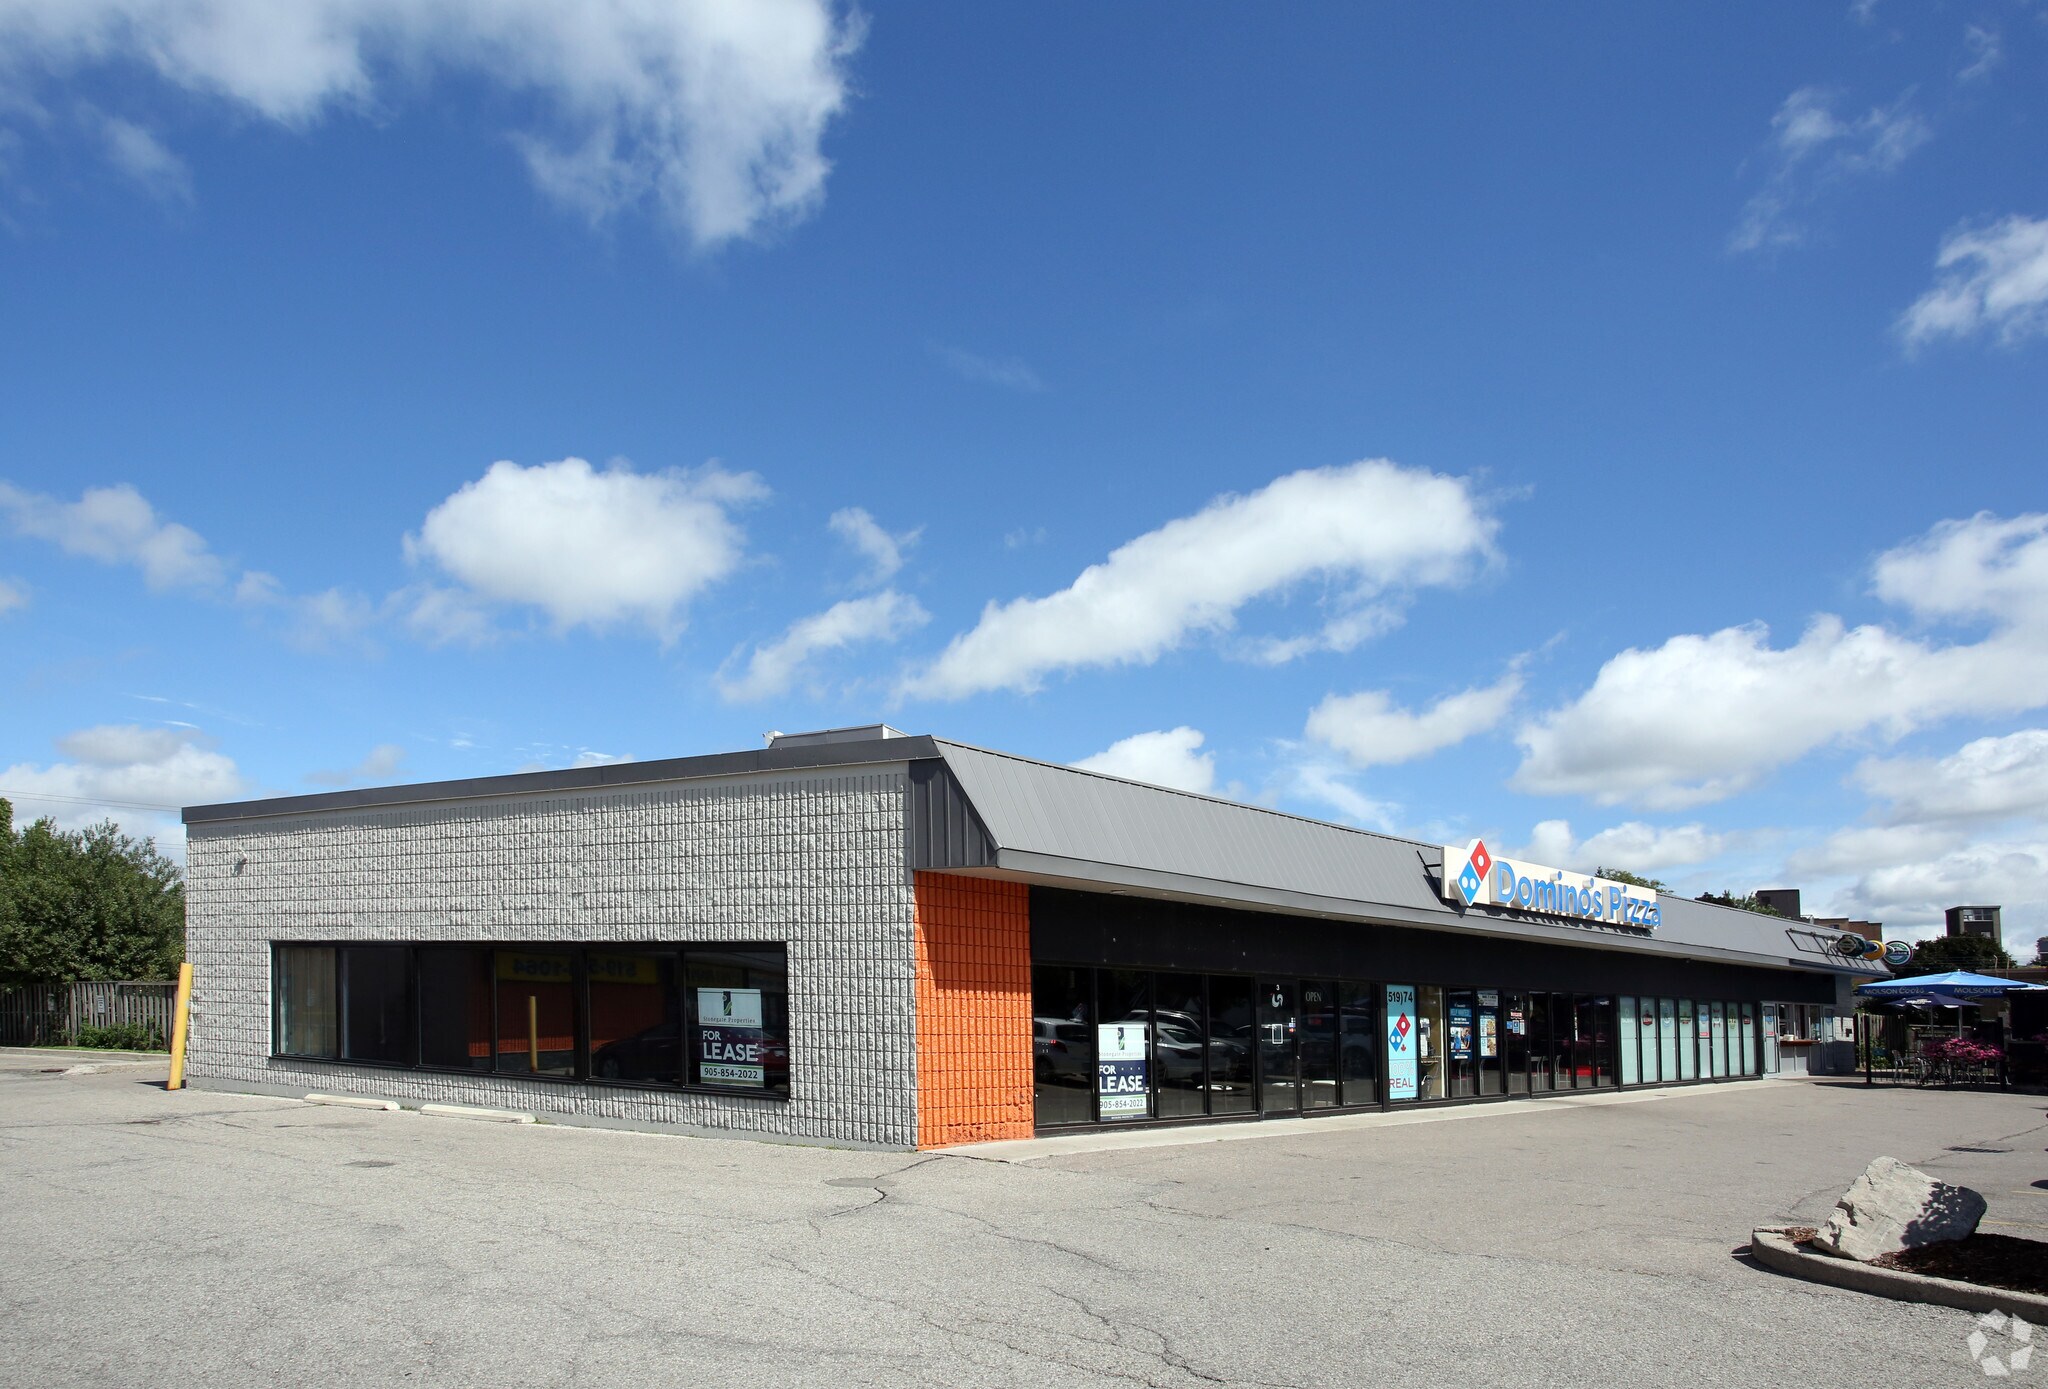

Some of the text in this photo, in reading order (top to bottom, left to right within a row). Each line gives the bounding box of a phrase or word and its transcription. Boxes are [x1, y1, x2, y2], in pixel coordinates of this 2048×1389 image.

[1496, 860, 1663, 927] Domino's Pizza
[1864, 986, 1926, 995] MOLSON Coors
[1953, 986, 1990, 994] MOLSON
[1305, 991, 1322, 1002] OPEN
[728, 1017, 756, 1025] Properties
[702, 1030, 722, 1041] FOR
[703, 1042, 759, 1062] LEASE
[704, 1067, 758, 1079] 905-854-2022
[1099, 1065, 1117, 1075] FOR
[1389, 1061, 1415, 1076] 00%
[1099, 1075, 1144, 1093] LEASE
[1389, 1077, 1415, 1089] REAL
[1099, 1098, 1144, 1109] 905-854-2022
